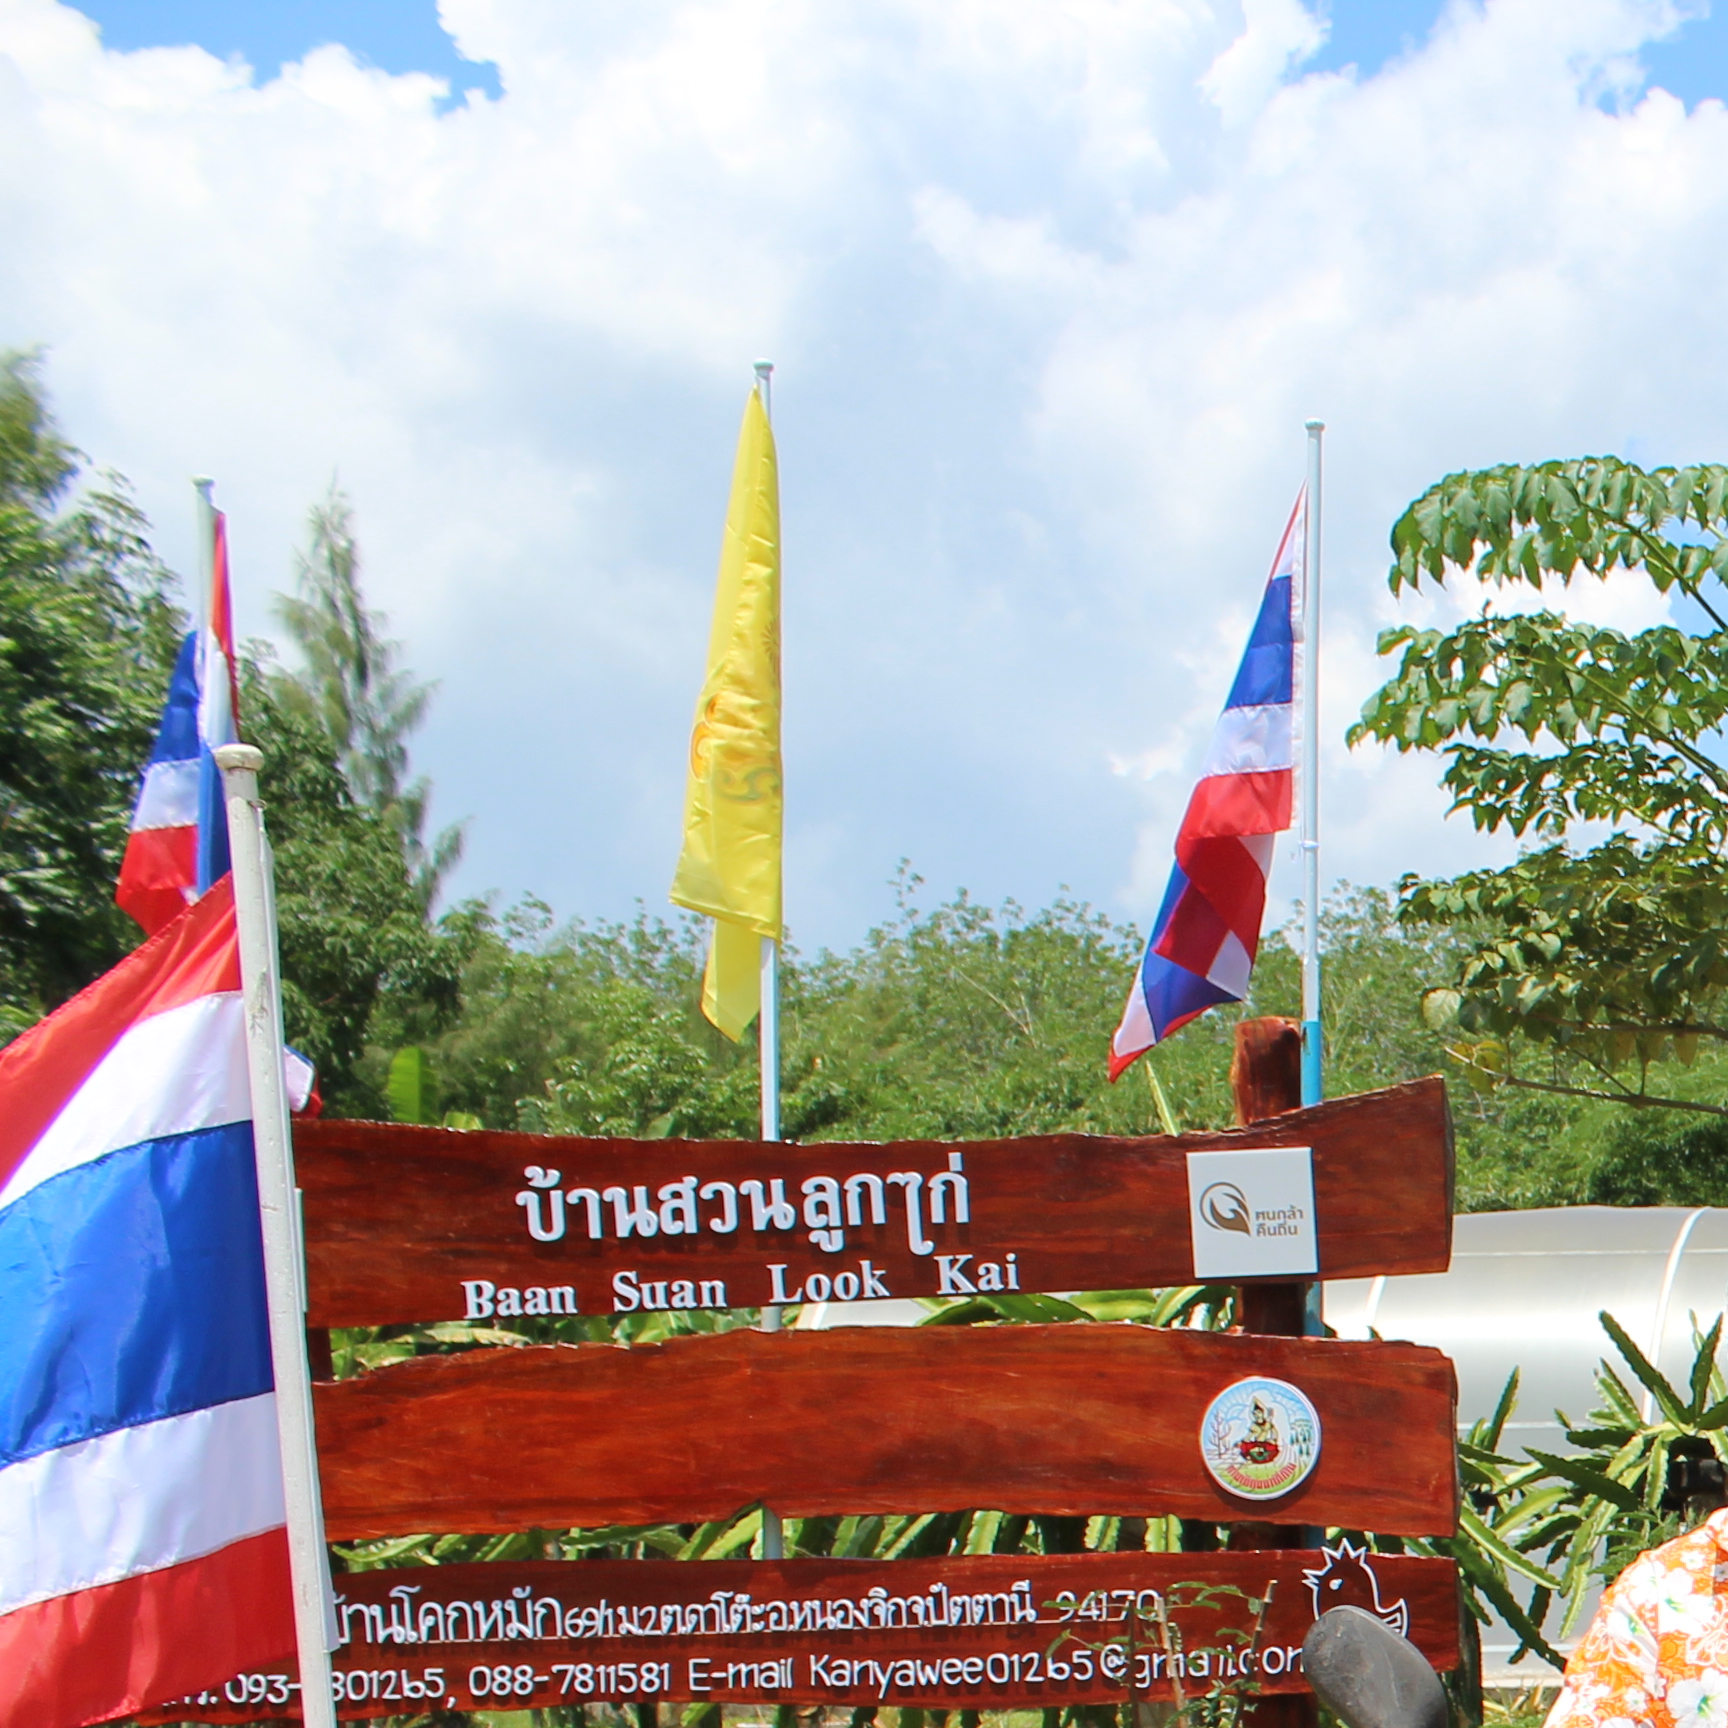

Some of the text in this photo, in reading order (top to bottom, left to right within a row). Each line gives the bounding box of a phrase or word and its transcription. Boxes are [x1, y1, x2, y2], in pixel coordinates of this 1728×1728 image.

[462, 1252, 1021, 1320] Baan Suan Look Kai
[469, 1662, 670, 1697] 088-7811581
[688, 1657, 794, 1691] E-mail
